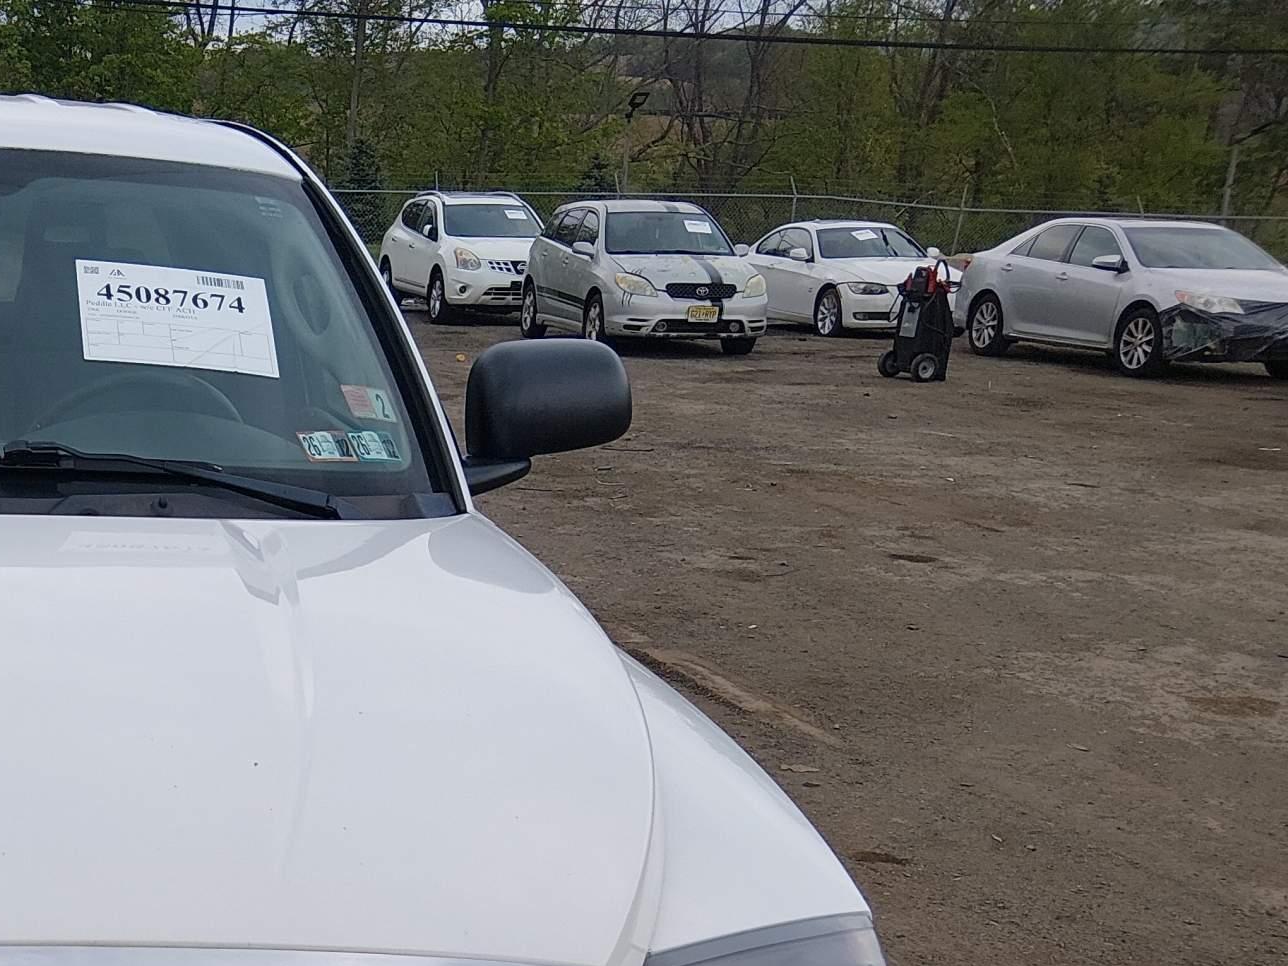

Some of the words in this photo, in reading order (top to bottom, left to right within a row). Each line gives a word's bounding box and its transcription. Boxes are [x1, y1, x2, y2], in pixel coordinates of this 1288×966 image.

[97, 283, 246, 314] 45087674
[302, 436, 322, 456] 26
[351, 434, 371, 456] 26
